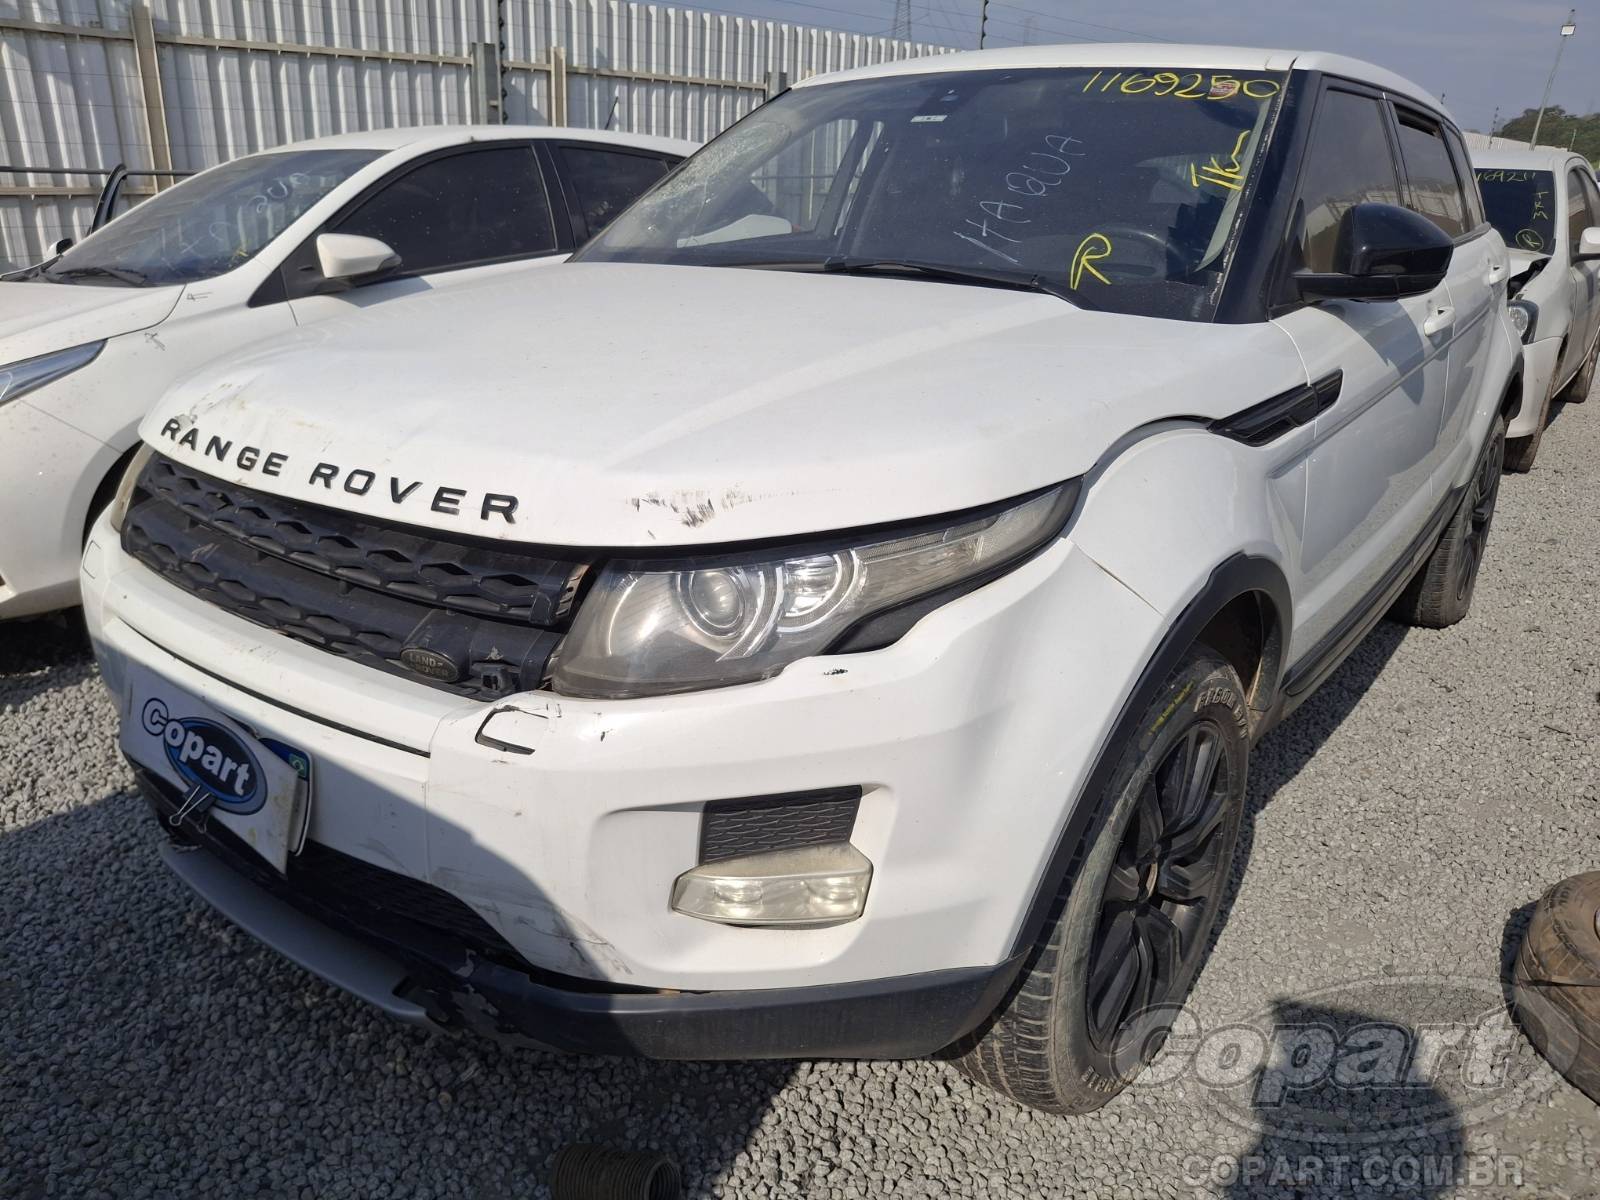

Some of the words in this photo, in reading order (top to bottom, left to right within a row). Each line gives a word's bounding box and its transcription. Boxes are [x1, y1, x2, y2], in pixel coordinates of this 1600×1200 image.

[1082, 71, 1280, 100] 1169250
[1070, 232, 1112, 290] R
[160, 417, 289, 477] RANGE
[308, 462, 520, 525] ROVER
[141, 697, 250, 796] Copart
